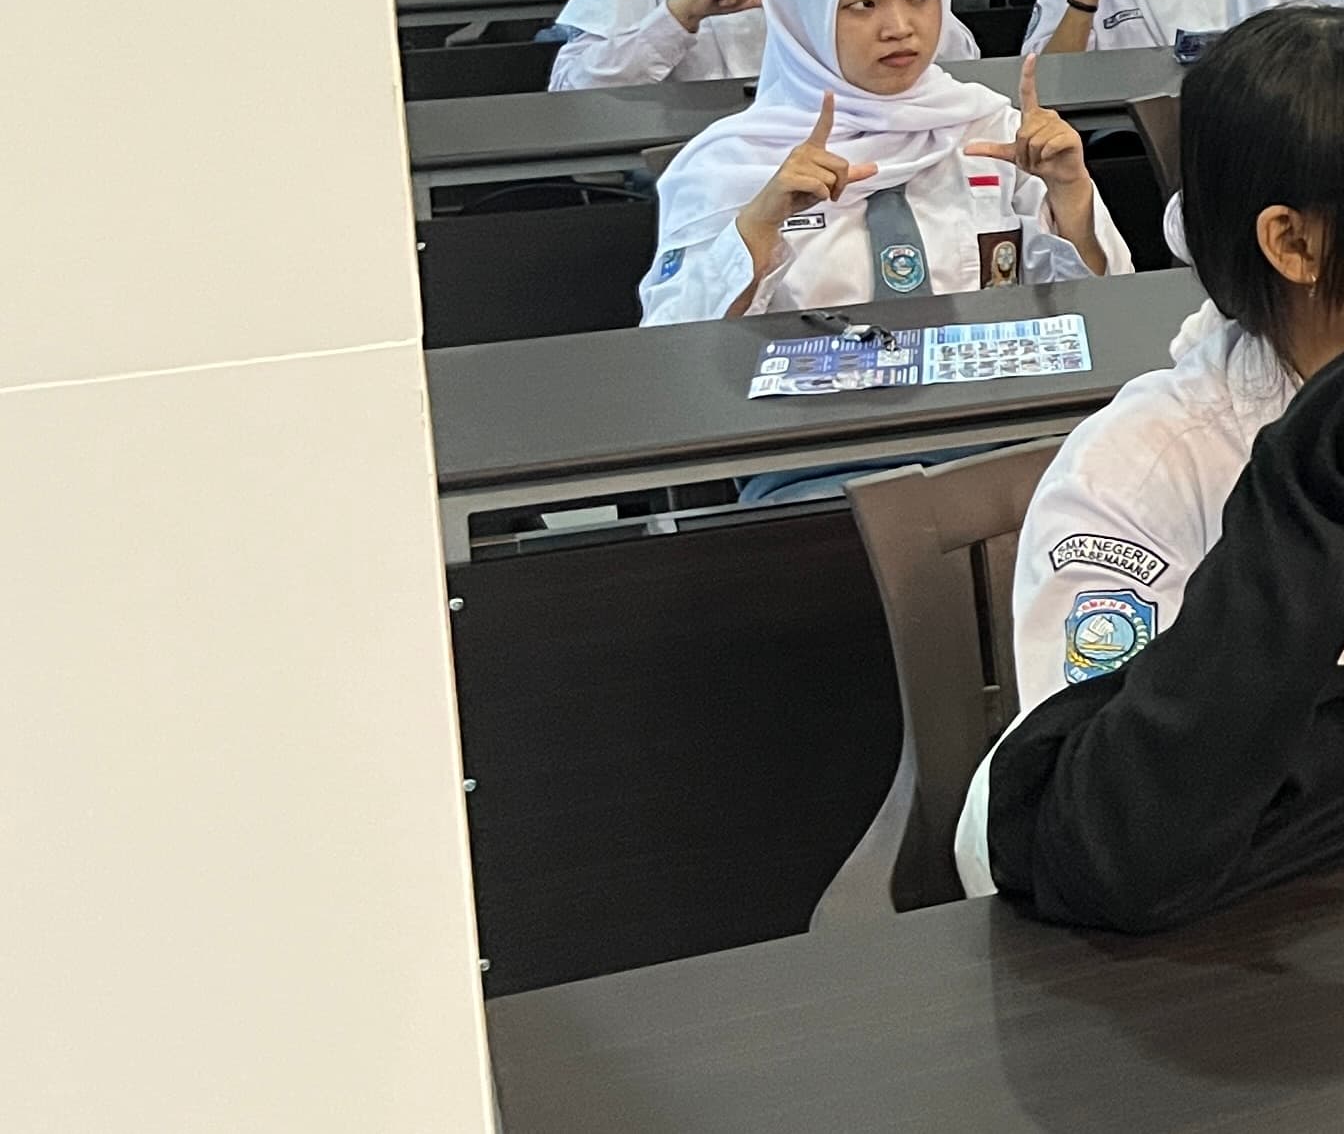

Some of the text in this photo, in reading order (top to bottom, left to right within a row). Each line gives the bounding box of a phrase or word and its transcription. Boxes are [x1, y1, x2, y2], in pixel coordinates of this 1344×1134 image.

[1058, 538, 1088, 553] SMK
[1092, 539, 1148, 564] NEGERI
[1088, 551, 1151, 581] SEMARANG
